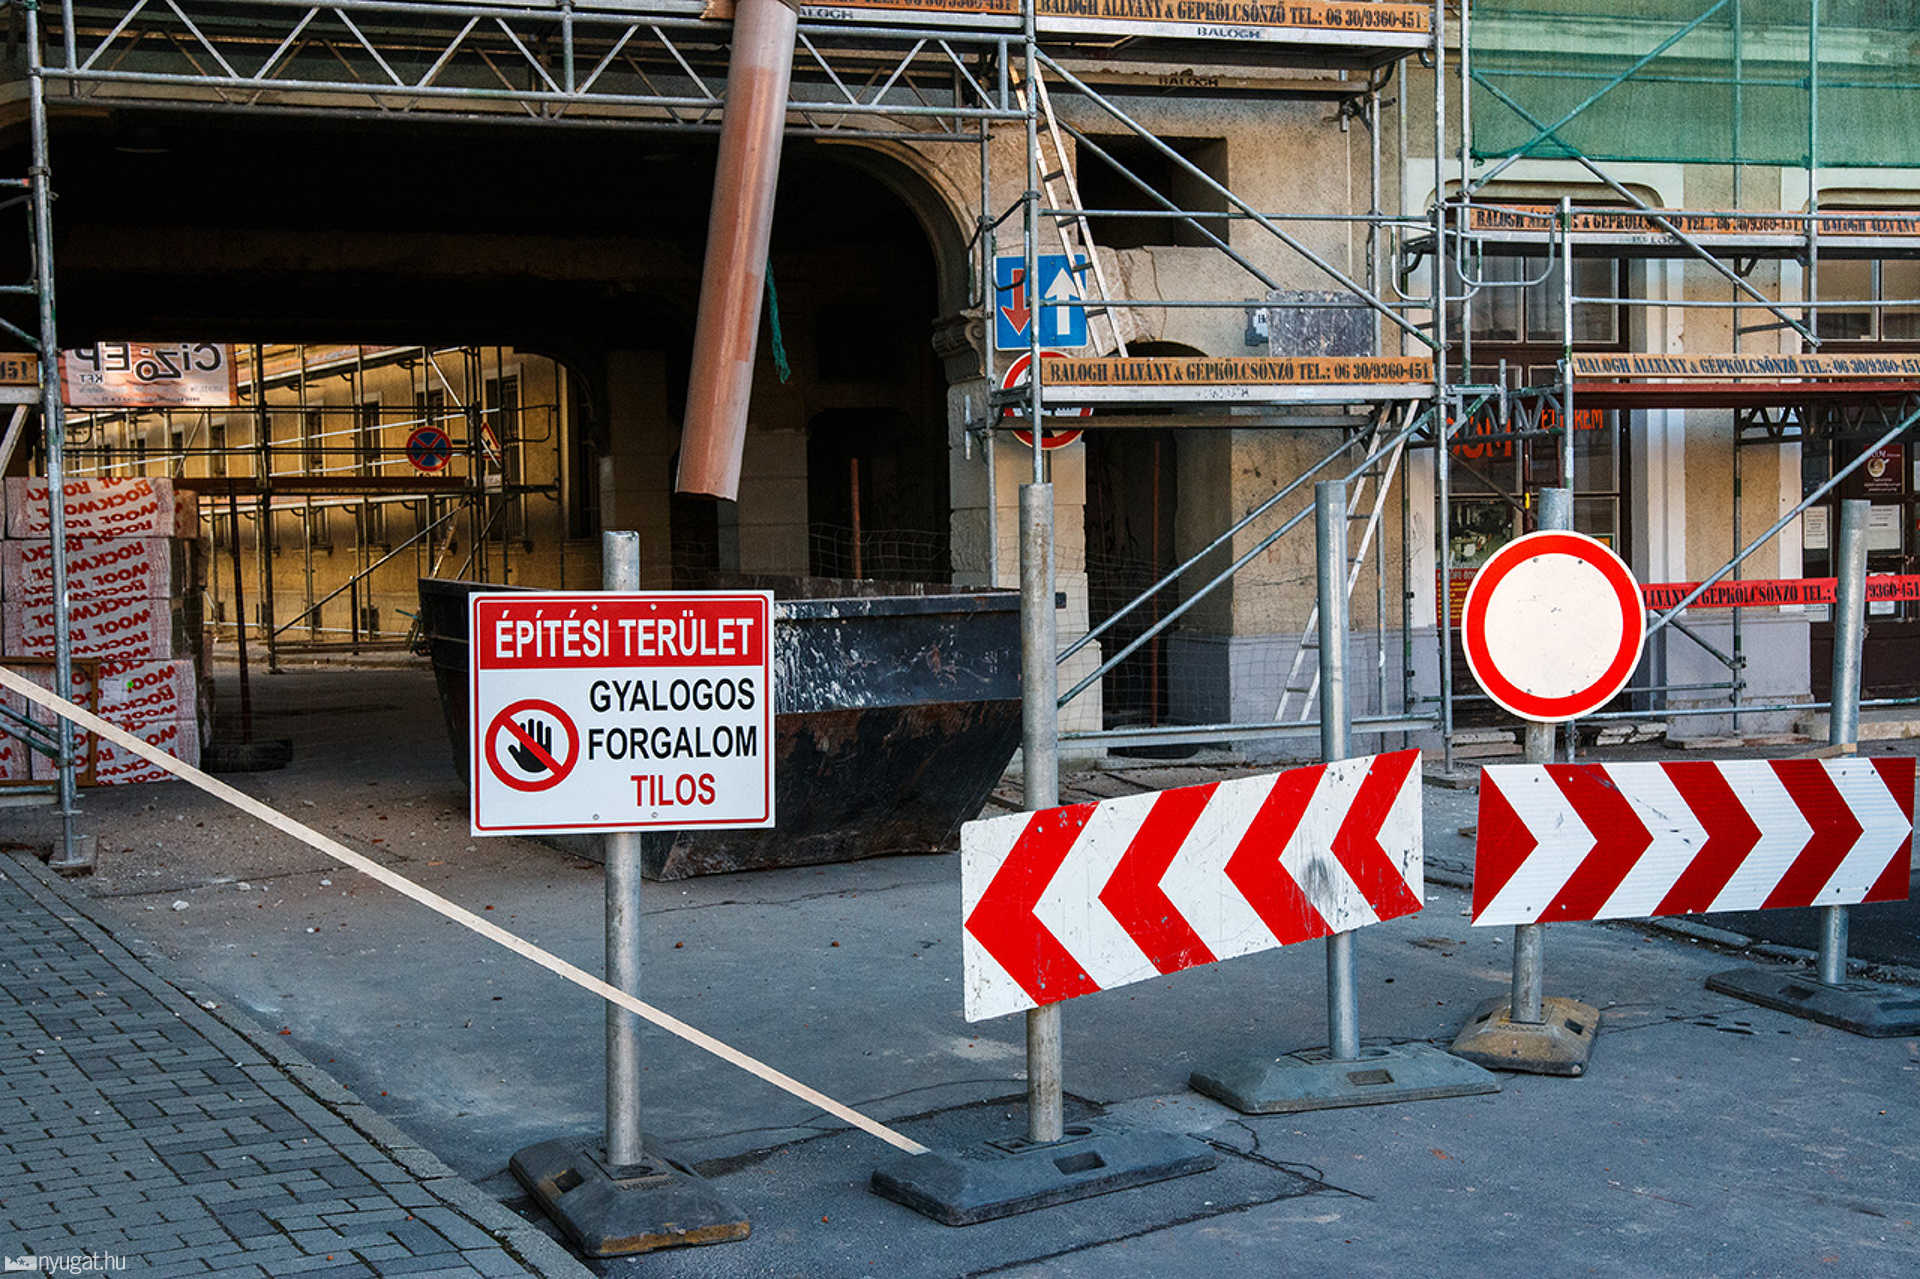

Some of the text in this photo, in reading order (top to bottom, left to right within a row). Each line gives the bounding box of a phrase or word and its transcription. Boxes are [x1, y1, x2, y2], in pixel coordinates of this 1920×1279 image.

[800, 8, 853, 20] ALOGH
[1326, 8, 1342, 26] 06
[1197, 26, 1260, 39] BALOGH
[1051, 363, 1107, 382] BALOGH
[1174, 365, 1183, 381] &
[1300, 363, 1330, 380] TEL.:
[1334, 362, 1350, 380] 06
[1353, 361, 1431, 381] 30/9360-451
[1576, 358, 1631, 374] BALOGH
[1833, 359, 1849, 374] 06
[496, 609, 754, 658] ÉPÍTÉSI TERÜLET
[590, 677, 755, 712] GYALOGOS
[588, 725, 757, 760] FORGALOM
[630, 773, 716, 807] TILOS
